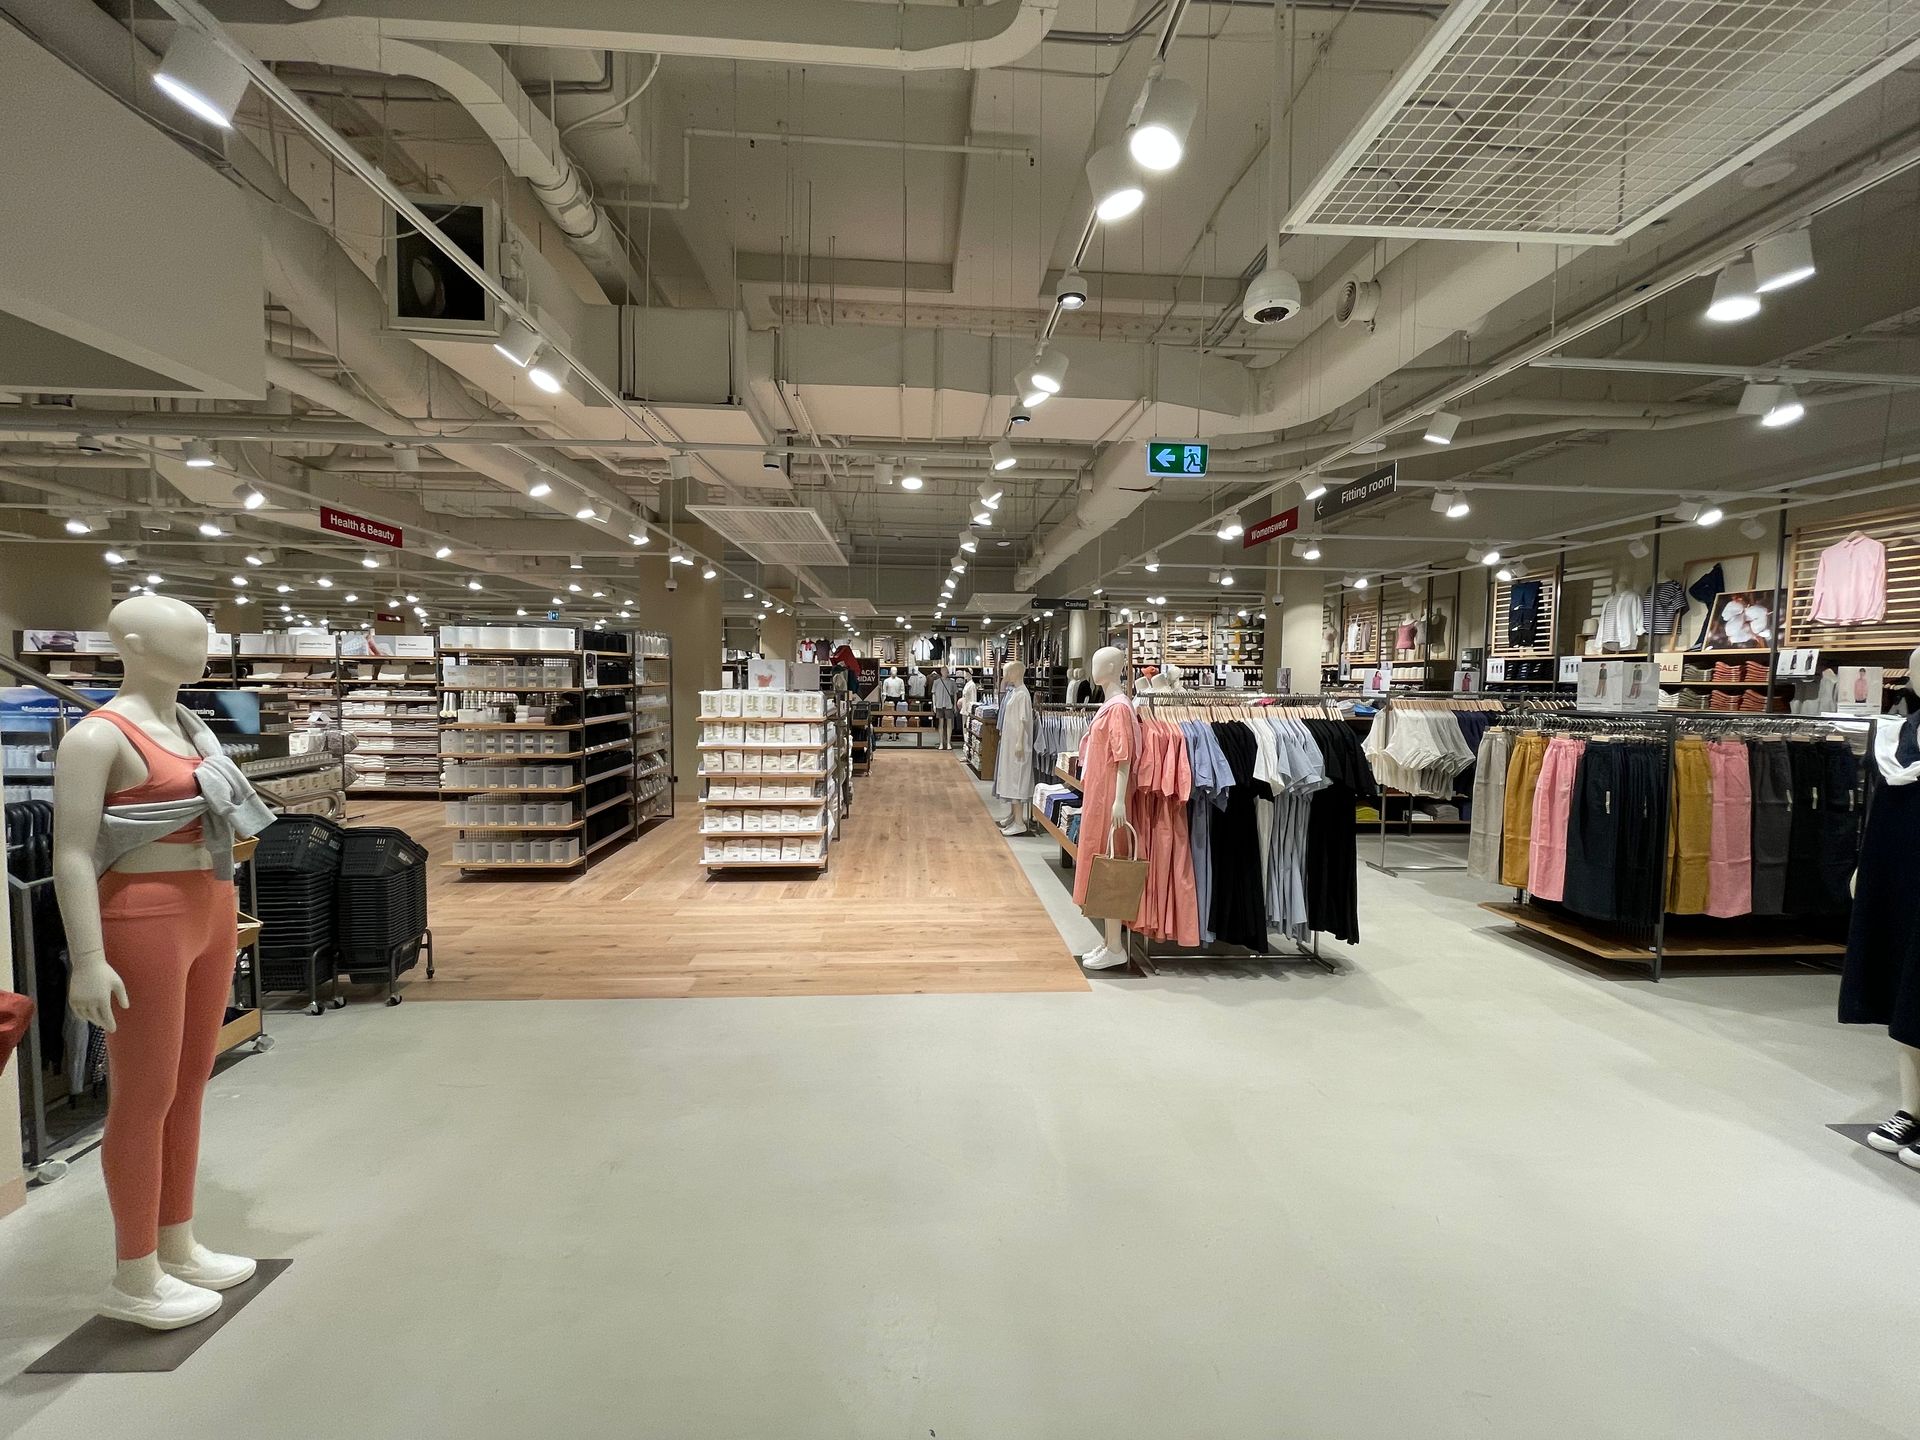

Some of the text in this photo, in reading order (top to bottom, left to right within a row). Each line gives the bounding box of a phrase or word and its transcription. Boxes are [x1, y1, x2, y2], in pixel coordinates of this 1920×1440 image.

[1341, 475, 1393, 504] Fitting room
[330, 513, 395, 542] Health & Beauty
[1251, 518, 1289, 540] Womenswear
